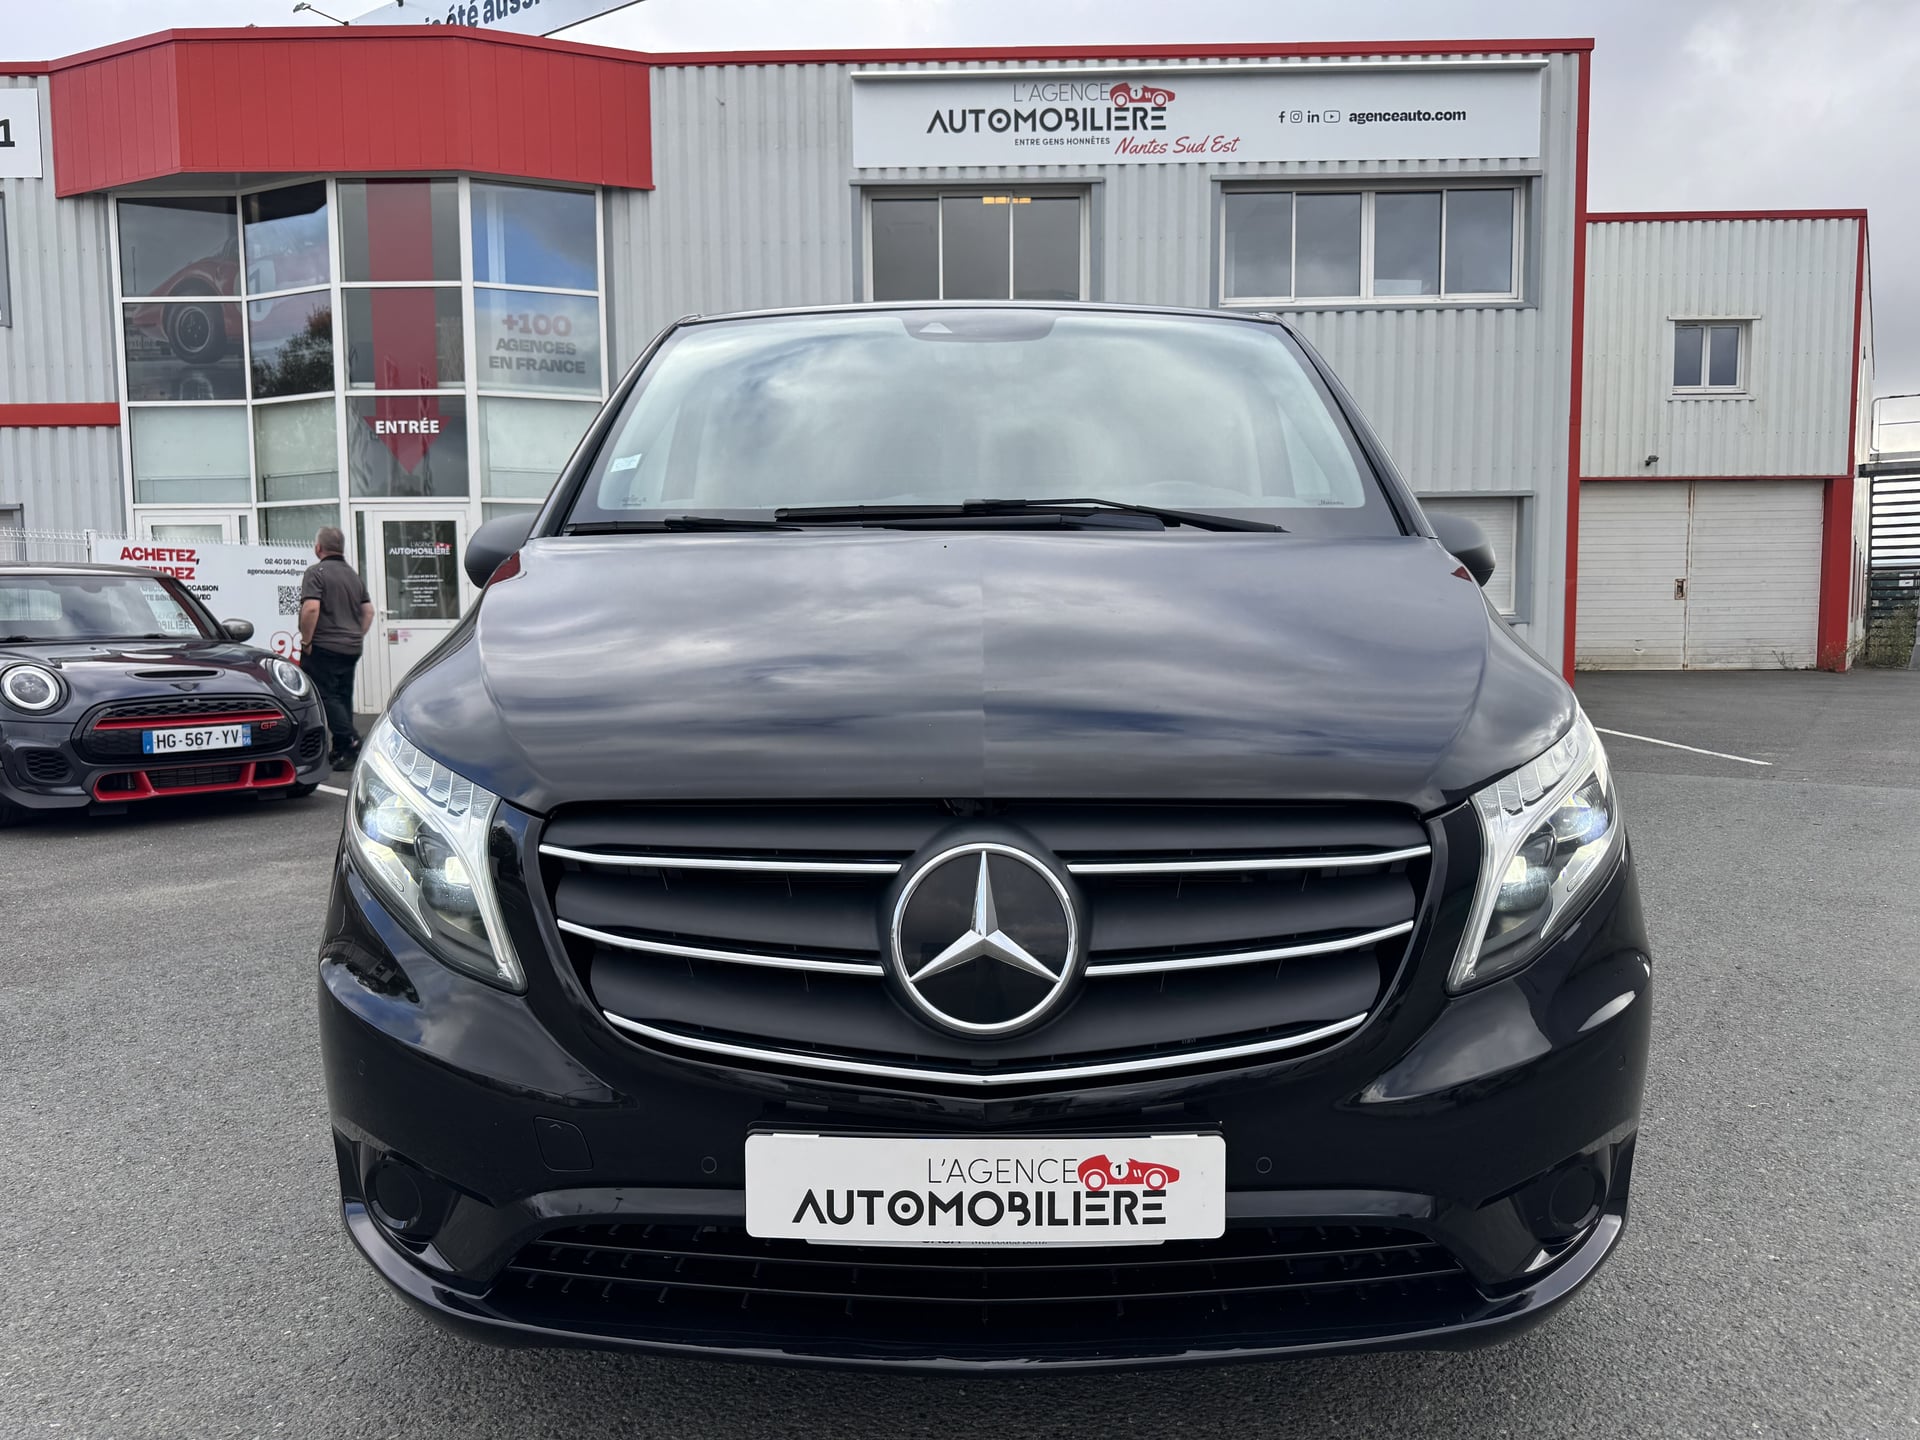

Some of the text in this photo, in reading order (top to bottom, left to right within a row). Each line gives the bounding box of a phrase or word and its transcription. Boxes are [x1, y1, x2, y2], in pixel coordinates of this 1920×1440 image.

[482, 0, 541, 24] aus
[1013, 82, 1109, 102] L'AGENCE
[1349, 110, 1466, 124] agenceauto.com
[1014, 135, 1110, 146] ENTRE GENS HONNÊTES
[1115, 135, 1241, 155] Nantes Sud Est
[502, 313, 572, 337] +100
[496, 338, 577, 355] AGENCES
[489, 356, 586, 374] EN FRANCE
[375, 417, 439, 434] ENTRÉE
[120, 547, 200, 565] ACHETEZ,
[195, 593, 211, 601] VEC
[260, 721, 278, 730] GP
[156, 729, 239, 749] HG-567-YV
[929, 1158, 1122, 1184] L'AGENCE 1
